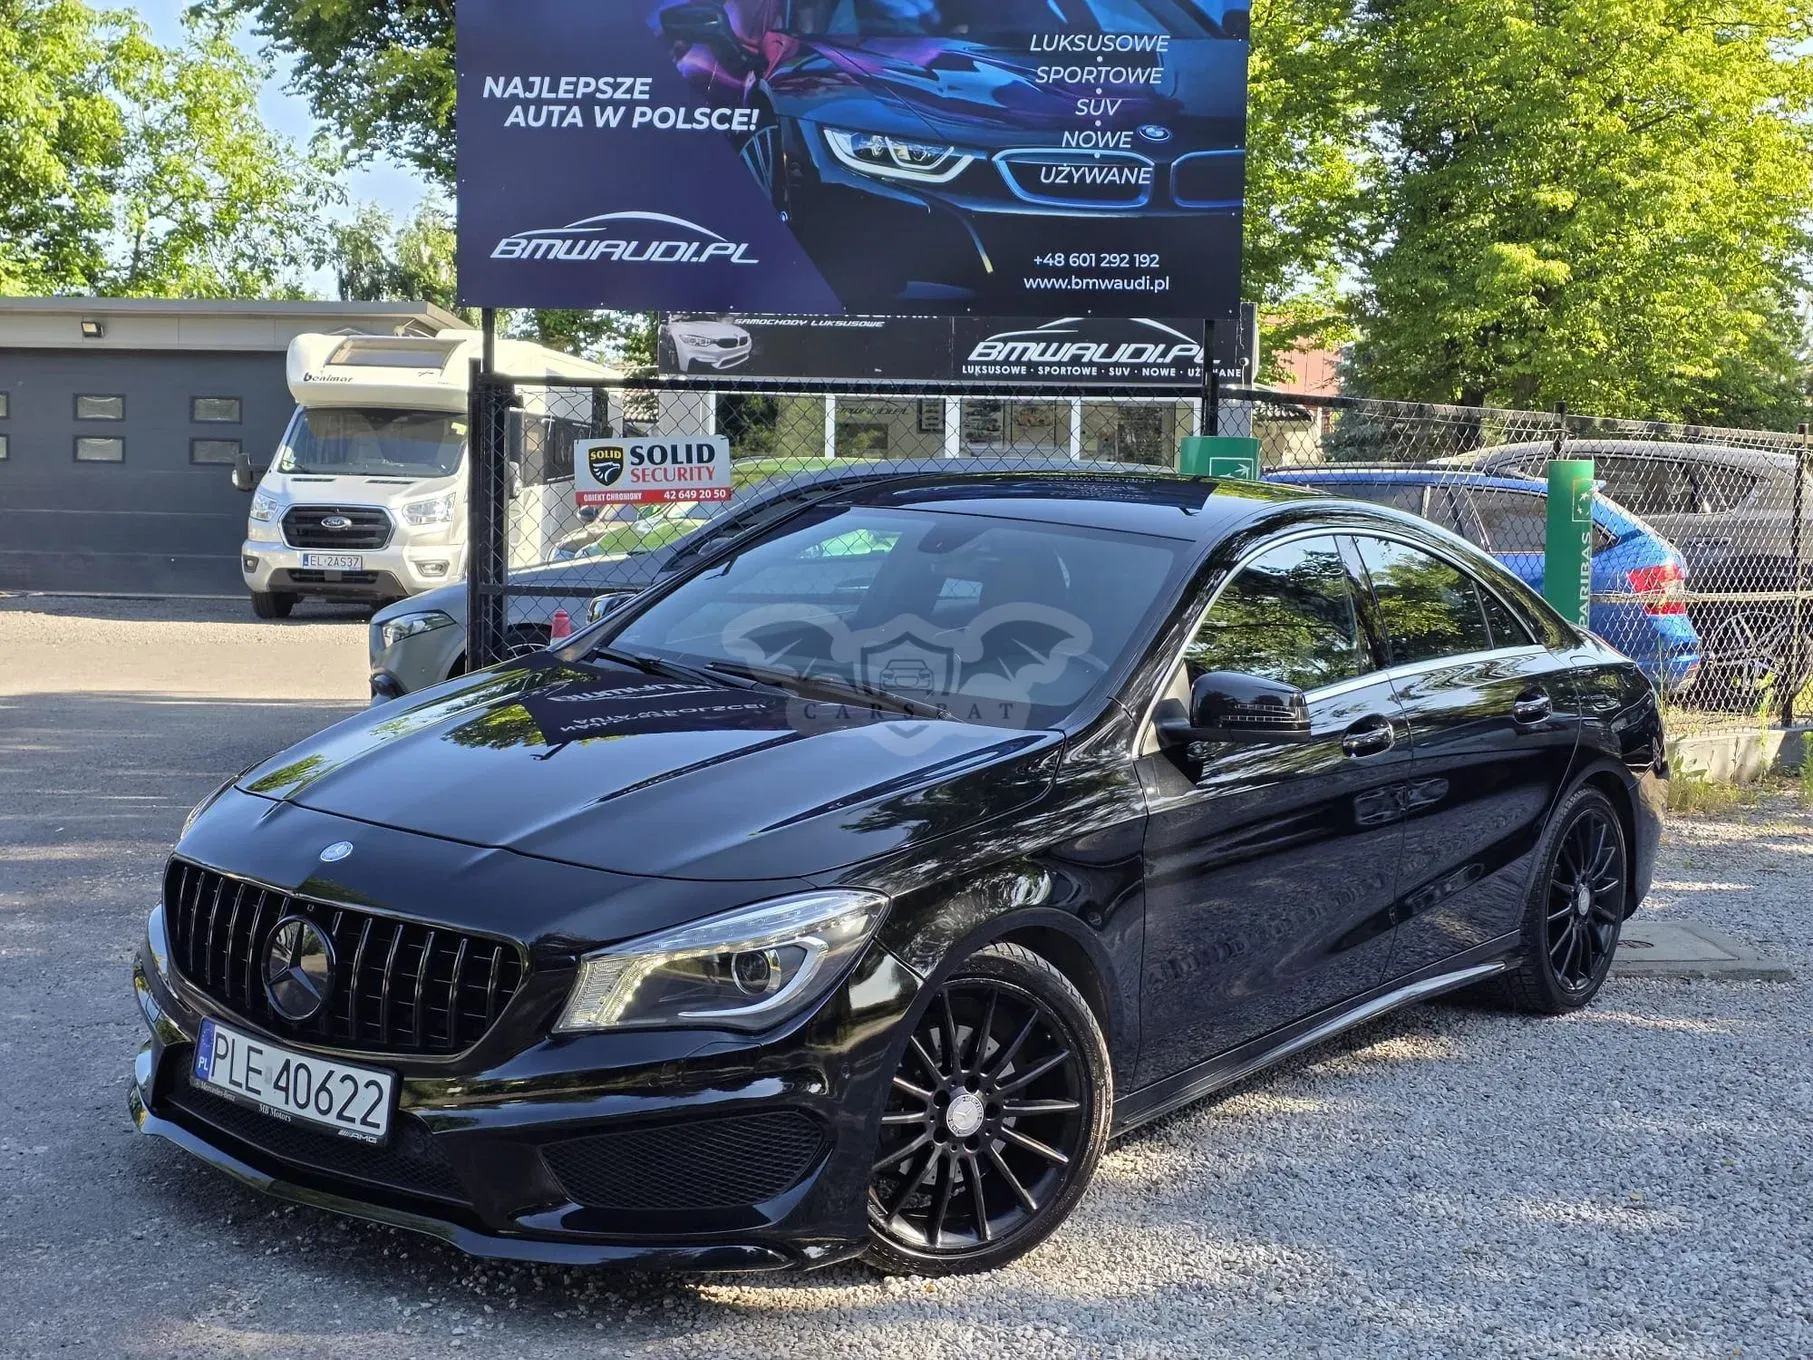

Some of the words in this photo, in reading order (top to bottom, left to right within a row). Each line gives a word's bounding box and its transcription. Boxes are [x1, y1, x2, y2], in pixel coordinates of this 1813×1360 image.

[1029, 34, 1171, 52] LUKSUSOWE
[1035, 66, 1164, 84] SPORTOWE
[483, 76, 652, 99] NAJLEPSZE
[1075, 98, 1122, 116] SUV
[504, 106, 584, 128] AUTA
[594, 107, 626, 128] W
[631, 108, 760, 131] POLSCE!
[1062, 131, 1133, 148] NOWE
[1040, 163, 1153, 185] UŻYWANE
[490, 238, 759, 264] BMWAUDI.PL
[1034, 253, 1065, 267] +48
[1069, 253, 1096, 267] 601
[1100, 253, 1129, 267] 292
[1133, 253, 1160, 267] 192
[1024, 275, 1170, 292] www.bmwaudi.pl
[734, 317, 807, 327] SAMOCHODY
[811, 320, 885, 328] LUKSUSOWE
[962, 365, 1026, 375] LUKSUSOWE
[1038, 366, 1097, 376] SPORTOWE
[1109, 367, 1130, 376] SUV
[1142, 367, 1175, 377] NOWE
[1187, 367, 1241, 377] UŻANE
[590, 450, 622, 460] SOLID
[629, 443, 716, 466] SOLID
[630, 465, 715, 483] SECURITY
[663, 490, 676, 499] 42
[678, 490, 697, 499] 649
[699, 490, 710, 499] 20
[713, 489, 726, 498] 50
[310, 555, 322, 566] EL
[327, 556, 360, 567] 2AS37
[1579, 531, 1592, 628] PARIBAS
[197, 1056, 209, 1071] PL
[211, 1032, 263, 1096] PLE
[273, 1058, 384, 1130] 40622
[271, 1106, 292, 1122] Motors
[349, 1131, 378, 1144] AMG
